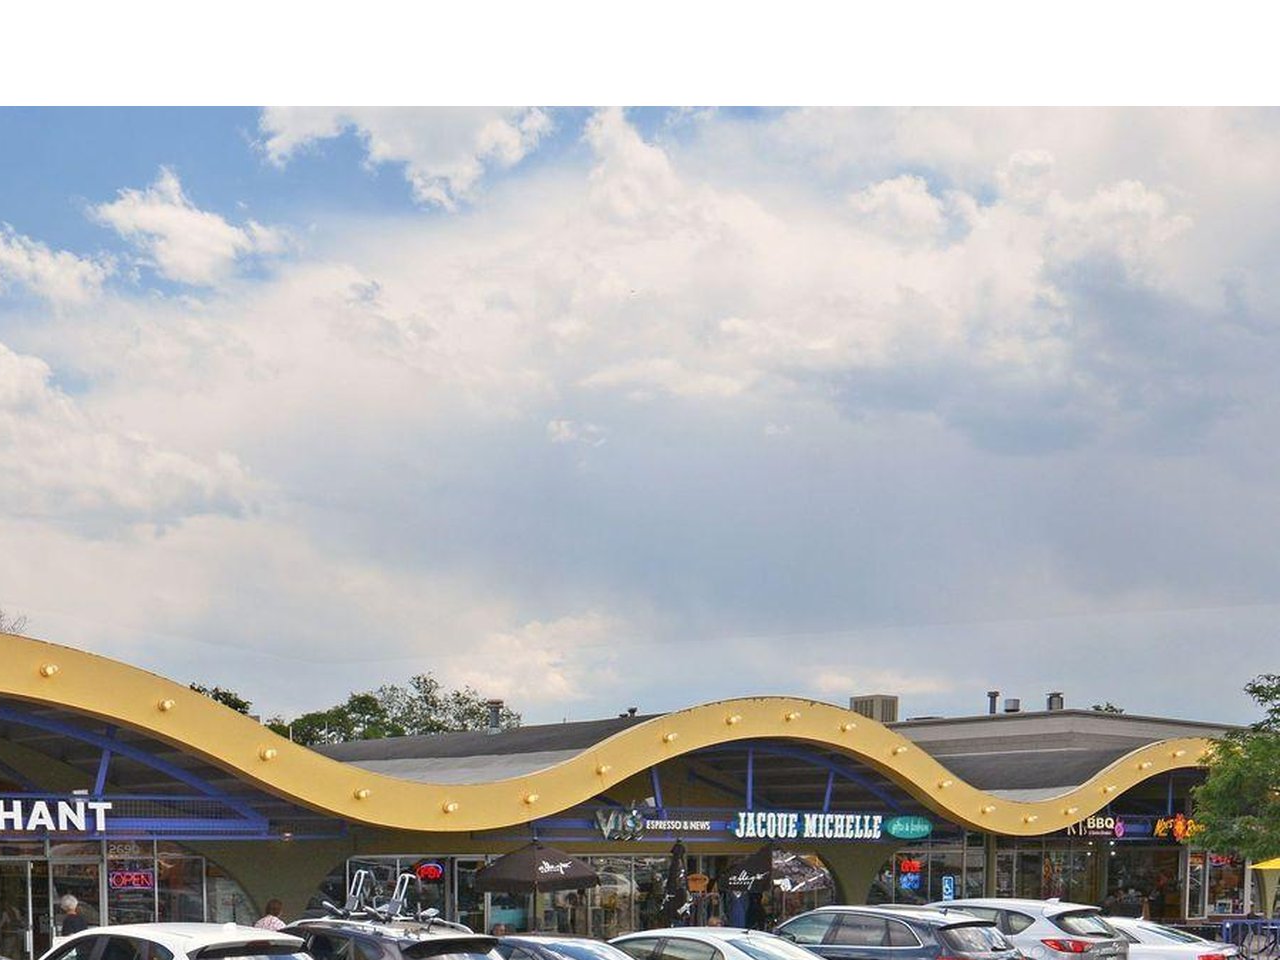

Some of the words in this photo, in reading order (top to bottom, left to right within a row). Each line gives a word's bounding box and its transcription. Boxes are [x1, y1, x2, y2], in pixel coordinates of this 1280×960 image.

[646, 820, 682, 830] ESPRESSO
[683, 820, 689, 830] &
[689, 821, 711, 831] NEWS
[803, 813, 883, 840] MICHELLE
[1087, 816, 1115, 829] BBQ
[113, 873, 151, 887] OPEN
